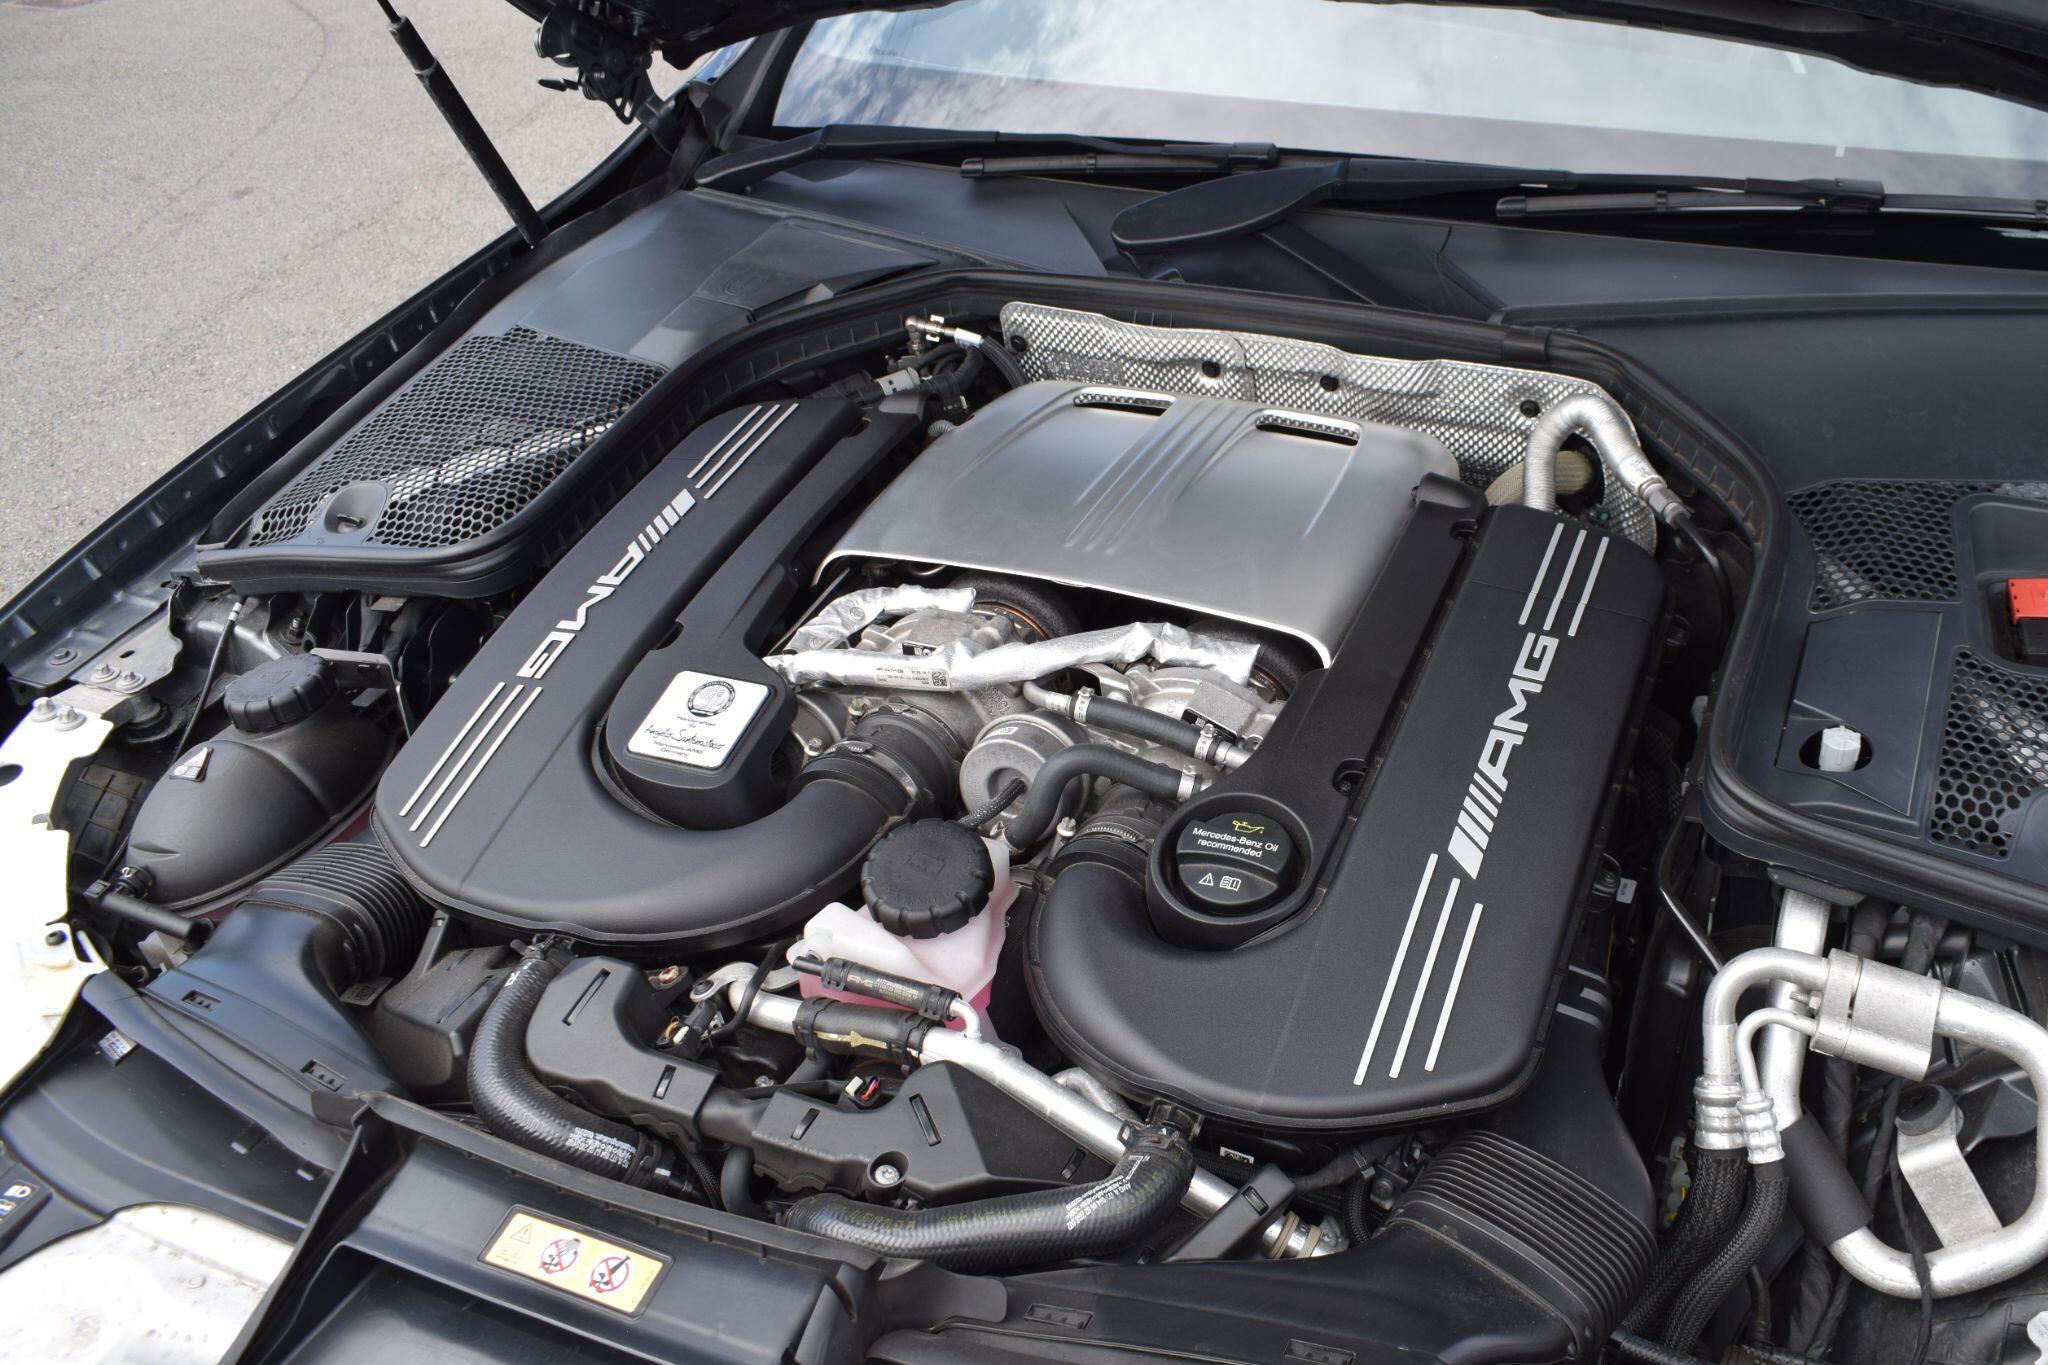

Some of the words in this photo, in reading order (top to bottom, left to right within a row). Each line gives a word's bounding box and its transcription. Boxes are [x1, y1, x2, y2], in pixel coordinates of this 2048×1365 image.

[517, 541, 645, 679] AMG
[1478, 632, 1560, 792] AMG
[1192, 827, 1263, 849] Mercedes-Benz
[1264, 843, 1279, 852] Oil
[1197, 838, 1263, 858] recommended
